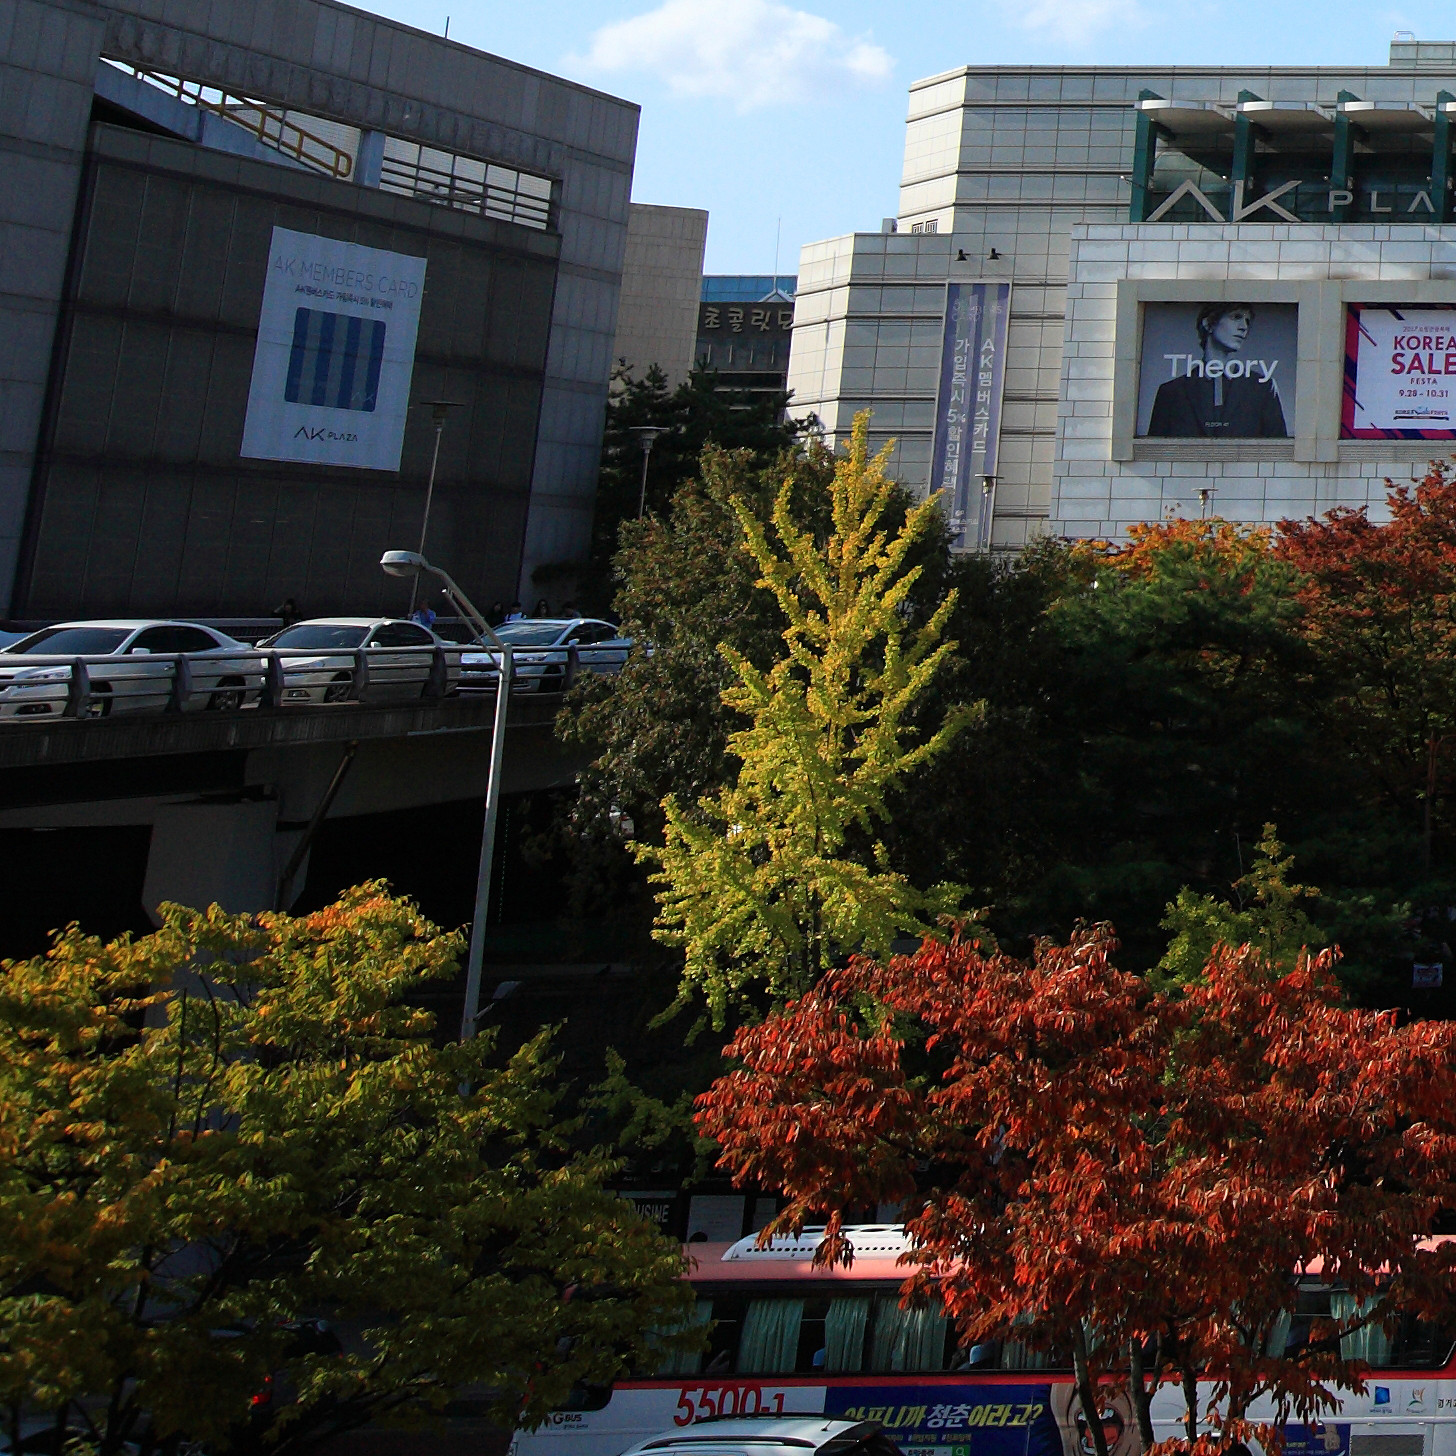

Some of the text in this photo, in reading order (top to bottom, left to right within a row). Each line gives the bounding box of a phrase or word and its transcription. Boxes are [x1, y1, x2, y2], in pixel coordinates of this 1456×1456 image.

[1146, 179, 1303, 222] AK
[274, 255, 418, 299] AK MEMBERS CARD
[1163, 354, 1279, 383] Theory
[293, 426, 358, 442] AK PLAZA
[633, 1203, 671, 1223] USINE
[673, 1383, 785, 1427] 5500-1
[926, 1403, 1044, 1428] 청춘이라고?
